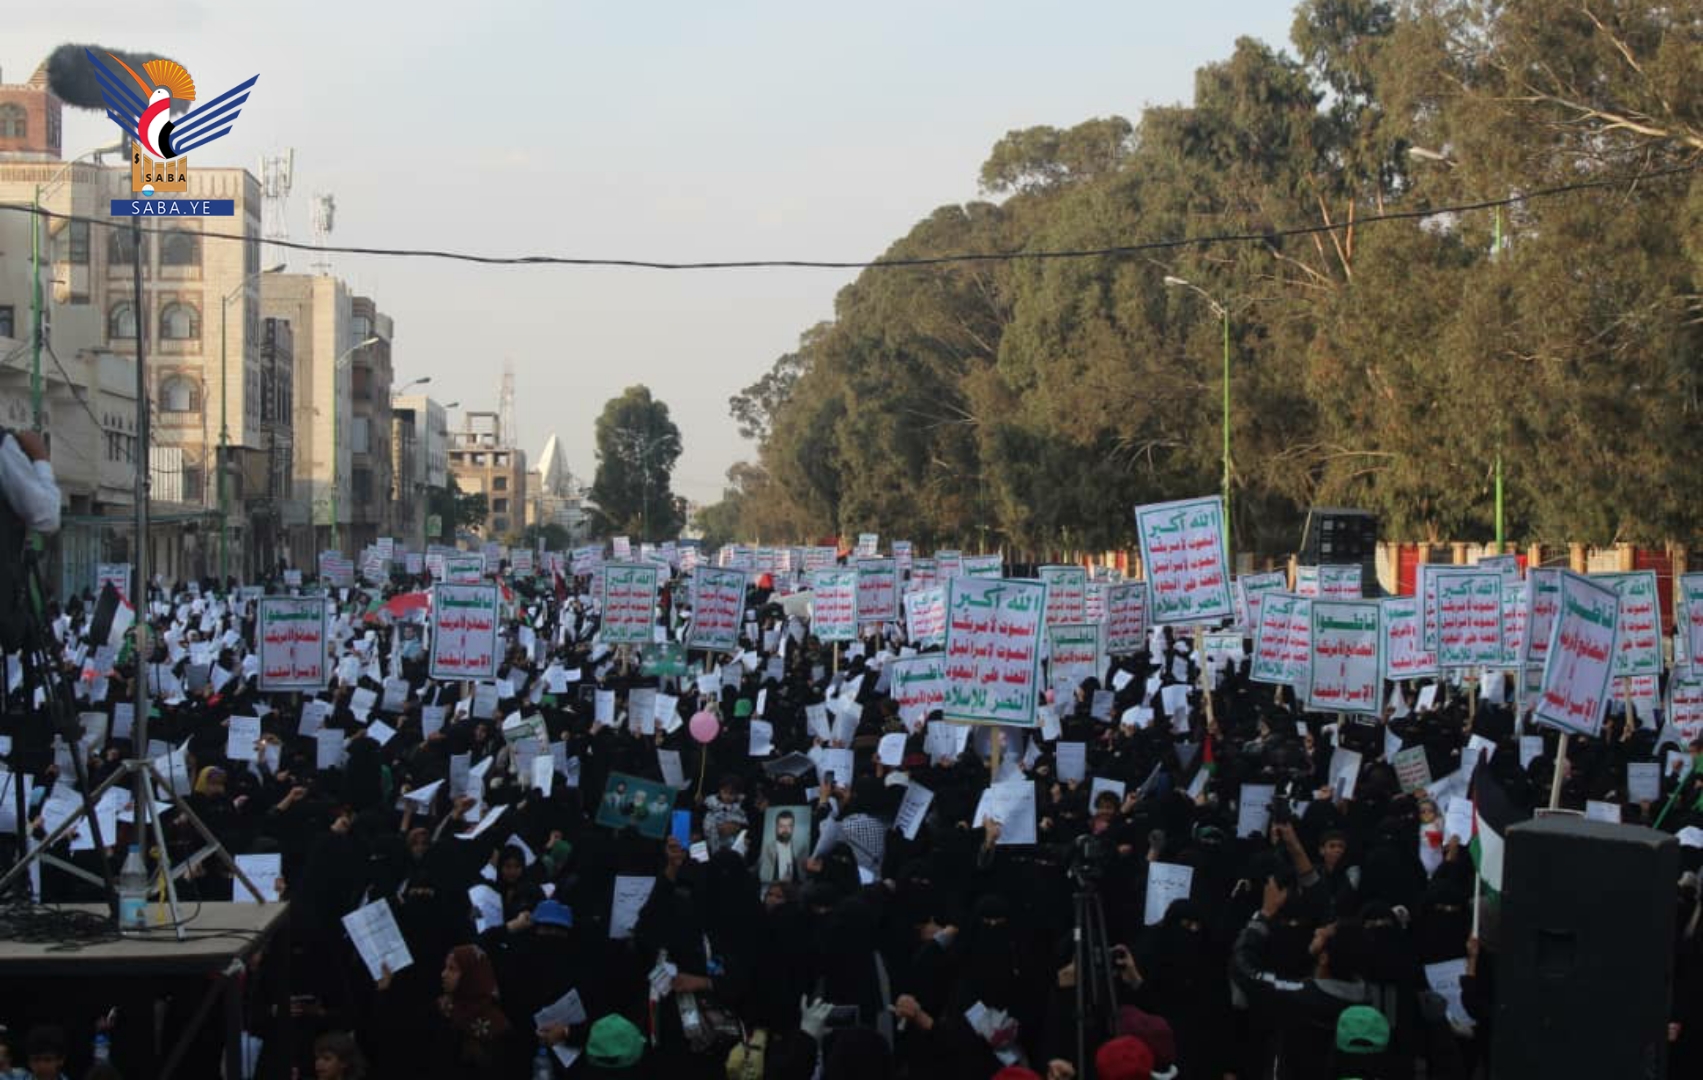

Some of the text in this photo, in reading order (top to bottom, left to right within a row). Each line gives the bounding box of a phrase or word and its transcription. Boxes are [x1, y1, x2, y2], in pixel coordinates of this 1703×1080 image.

[1148, 510, 1216, 539] الله أكبر
[1188, 533, 1218, 550] الموت
[1190, 552, 1219, 568] الموت
[1155, 575, 1180, 593] اليهود
[1184, 576, 1196, 592] على
[953, 583, 1040, 612] الله أكبر
[1196, 588, 1229, 613] النصر
[1566, 593, 1614, 629] قاطعوا
[951, 612, 1036, 638] الموت لأمريكا
[1315, 612, 1377, 633] قاطعوا
[996, 645, 1034, 663] الموت
[945, 663, 1031, 686] اللعنة على اليهود
[1340, 662, 1345, 677] و
[991, 688, 1030, 714] النصر
[1313, 682, 1375, 702] الإسرائيلية
